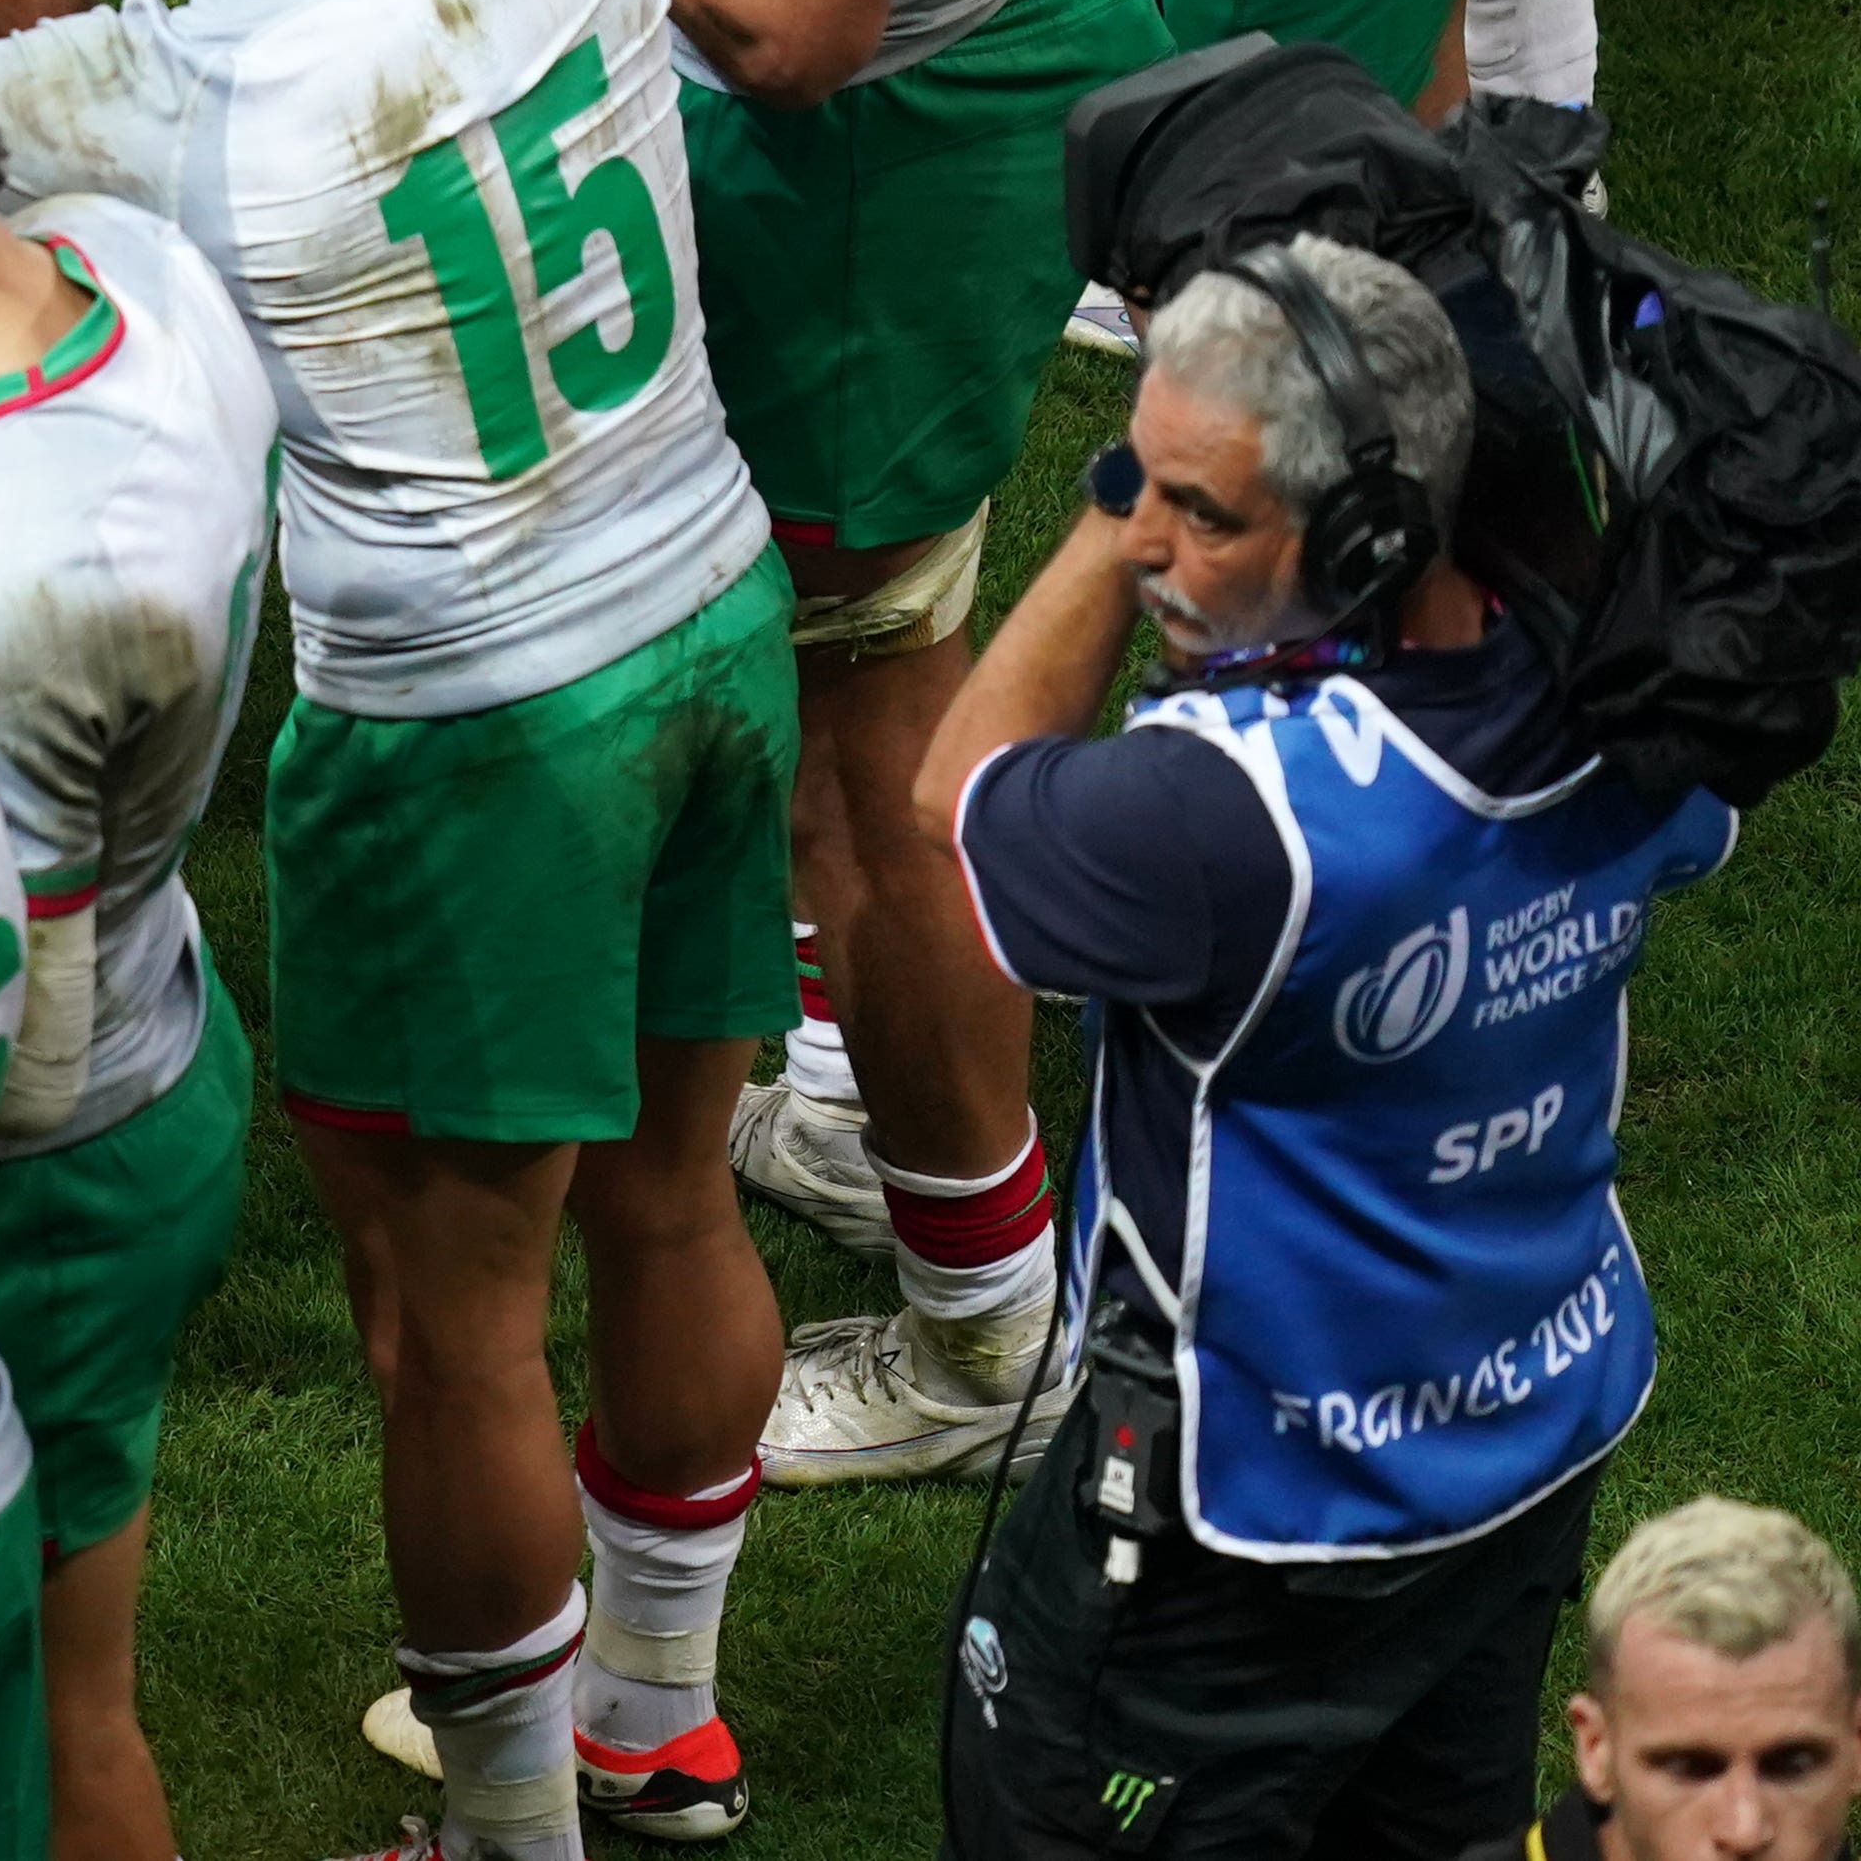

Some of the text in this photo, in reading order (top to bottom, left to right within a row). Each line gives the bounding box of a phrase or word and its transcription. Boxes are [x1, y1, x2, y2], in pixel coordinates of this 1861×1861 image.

[378, 33, 675, 479] 15
[1485, 900, 1639, 992] WORLD
[1486, 880, 1576, 951] RUGBY
[1472, 962, 1588, 1030] FRANCE
[1428, 1081, 1565, 1184] SPP
[1271, 1338, 1532, 1453] FRANCE
